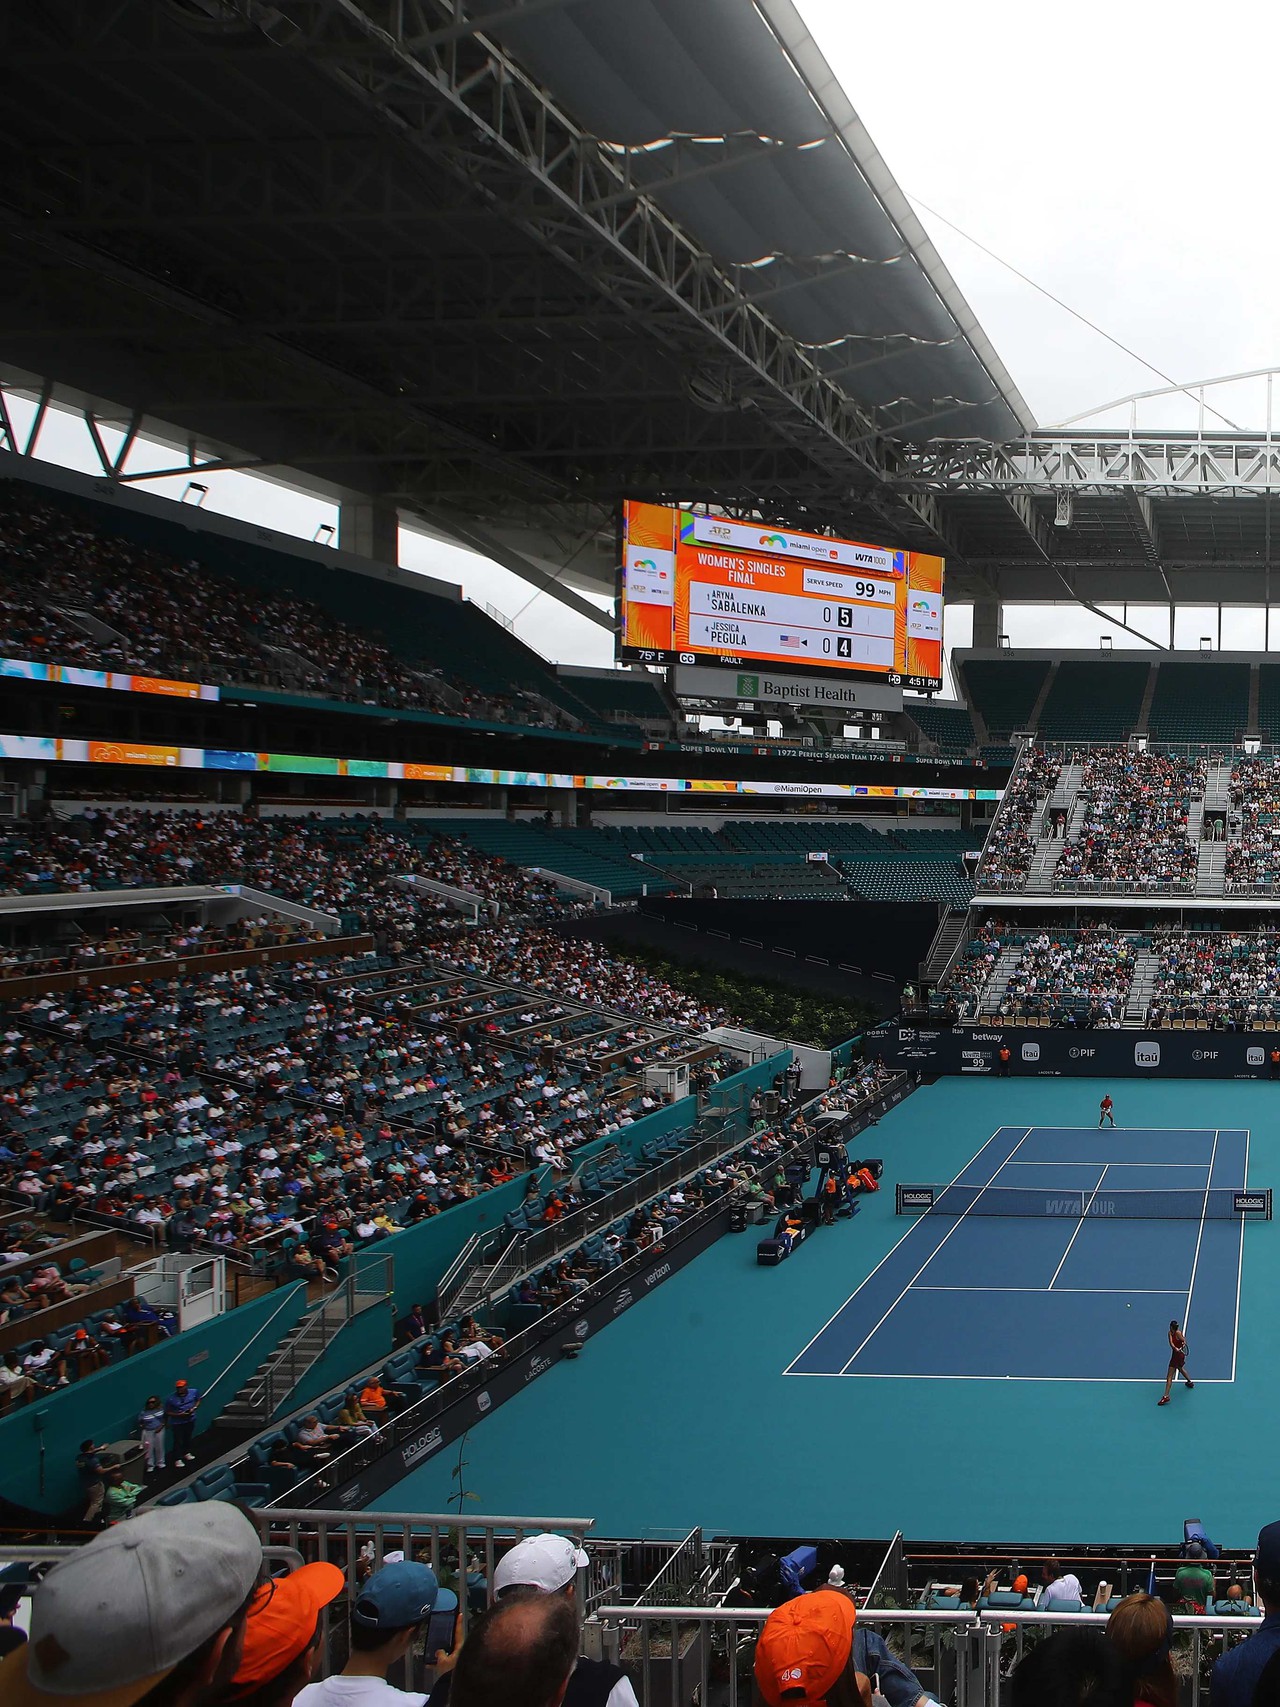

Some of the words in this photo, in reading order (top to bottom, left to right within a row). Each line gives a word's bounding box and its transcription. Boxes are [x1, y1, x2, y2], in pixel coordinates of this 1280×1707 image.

[789, 541, 811, 551] miami
[697, 552, 745, 571] WOMEN'S
[747, 561, 786, 578] SINGLES
[727, 571, 756, 586] FINAL
[807, 577, 826, 587] SERVE
[826, 580, 843, 589] SPEED
[711, 590, 735, 601] ARYNA
[855, 581, 875, 598] 99
[879, 589, 891, 597] MPH
[711, 600, 766, 617] SABALENKA
[823, 606, 831, 623] 0
[840, 609, 850, 626] 5
[710, 621, 740, 633] JESSICA
[711, 632, 747, 646] PEGULA
[822, 637, 830, 654] 0
[839, 640, 849, 656] 4
[681, 654, 694, 663] CC
[720, 655, 743, 665] FAULT.
[909, 678, 925, 686] 4:51
[927, 679, 938, 687] PM
[763, 681, 810, 699] Baptist
[814, 685, 856, 702] Health
[680, 744, 702, 753] SUPER
[705, 746, 726, 754] BOWL
[777, 749, 796, 757] 1972
[798, 750, 823, 759] PERFECT
[825, 752, 849, 760] SEASON
[851, 753, 867, 761] TEAM
[774, 784, 822, 795] @MiamiOpen
[972, 1032, 1003, 1042] betway
[1080, 1049, 1096, 1057] PIF
[1203, 1051, 1219, 1059] PIF
[972, 1058, 985, 1067] 99
[1045, 1200, 1080, 1214] WTA
[644, 1262, 671, 1286] verizon
[524, 1357, 552, 1381] LACOSTE
[401, 1427, 441, 1460] HOLOGIC
